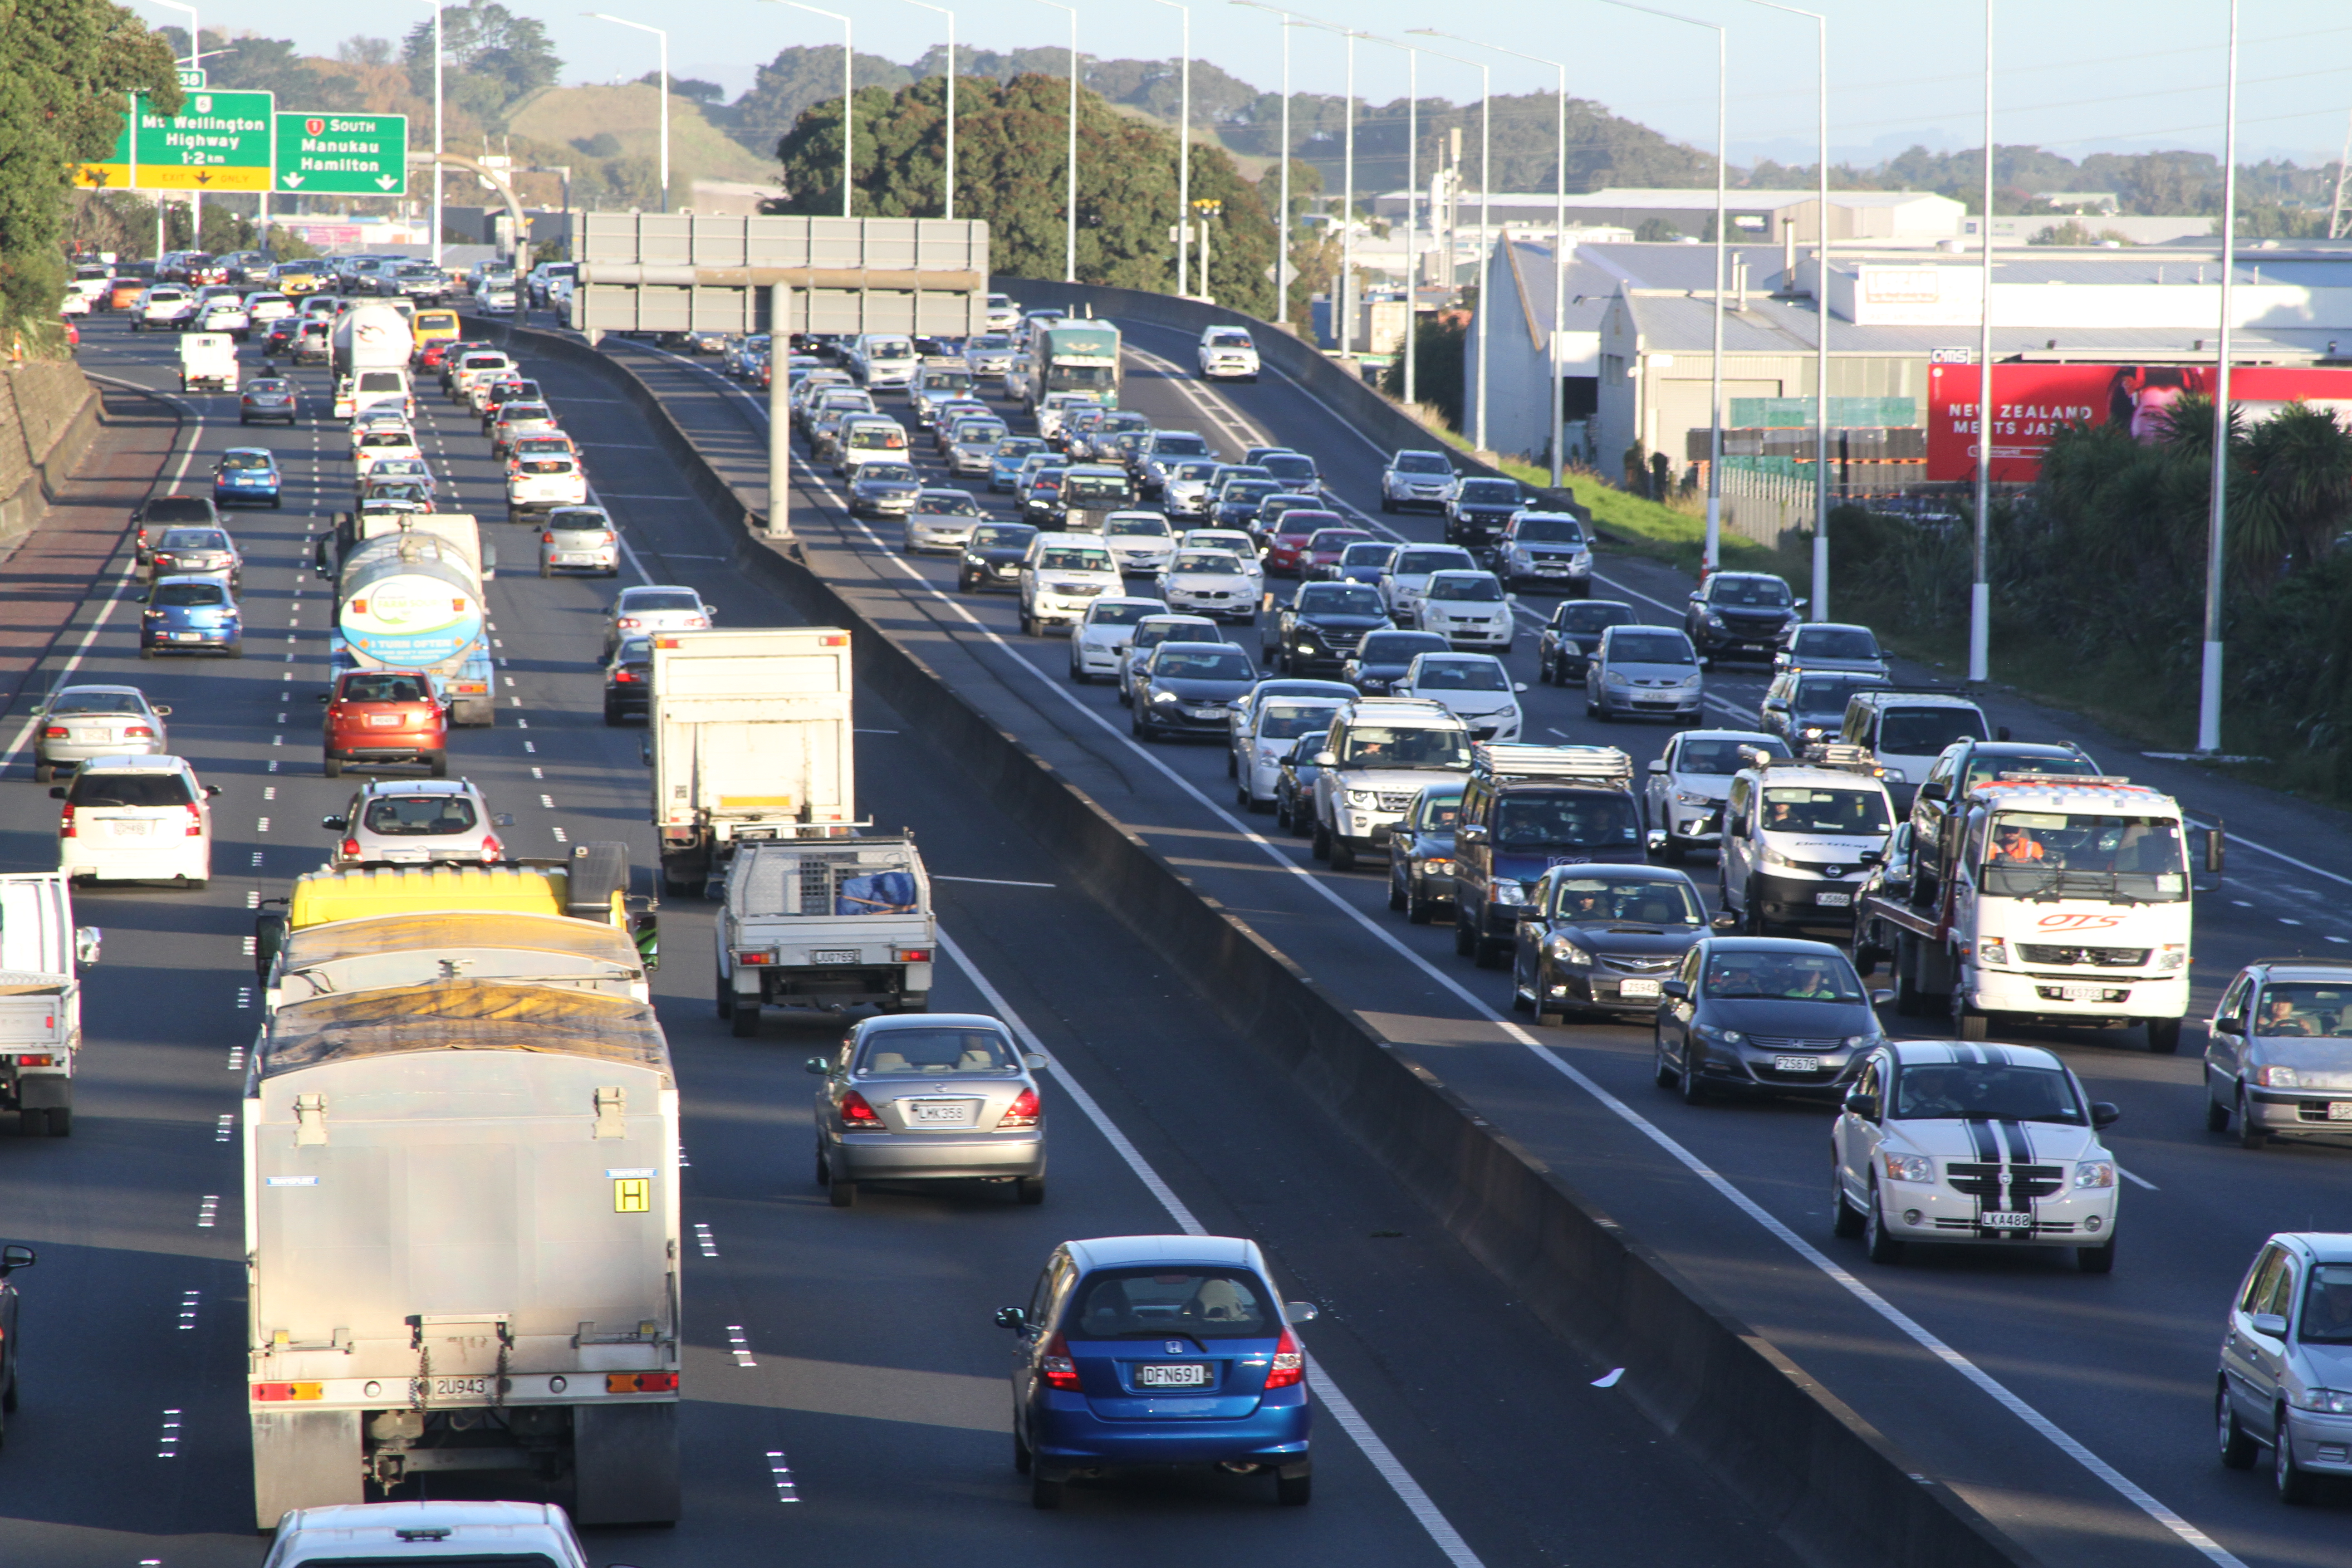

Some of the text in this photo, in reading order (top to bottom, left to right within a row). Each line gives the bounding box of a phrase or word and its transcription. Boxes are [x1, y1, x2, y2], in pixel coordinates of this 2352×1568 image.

[142, 115, 265, 133] Mt Wellington
[312, 121, 318, 132] 1
[166, 132, 240, 150] Highway
[301, 138, 380, 153] Manukau
[207, 154, 226, 163] km
[301, 157, 380, 172] Hamilton
[162, 173, 249, 183] EXIT ONLY
[2000, 404, 2093, 419] ZEALAND
[1953, 420, 2016, 435] METS
[371, 639, 452, 648] I TURN OFTEN
[2037, 913, 2128, 933] OTS
[1776, 1057, 1818, 1071] FZS676
[622, 1181, 641, 1210] H
[1146, 1367, 1201, 1383] DFN691
[437, 1378, 485, 1395] 2U943
